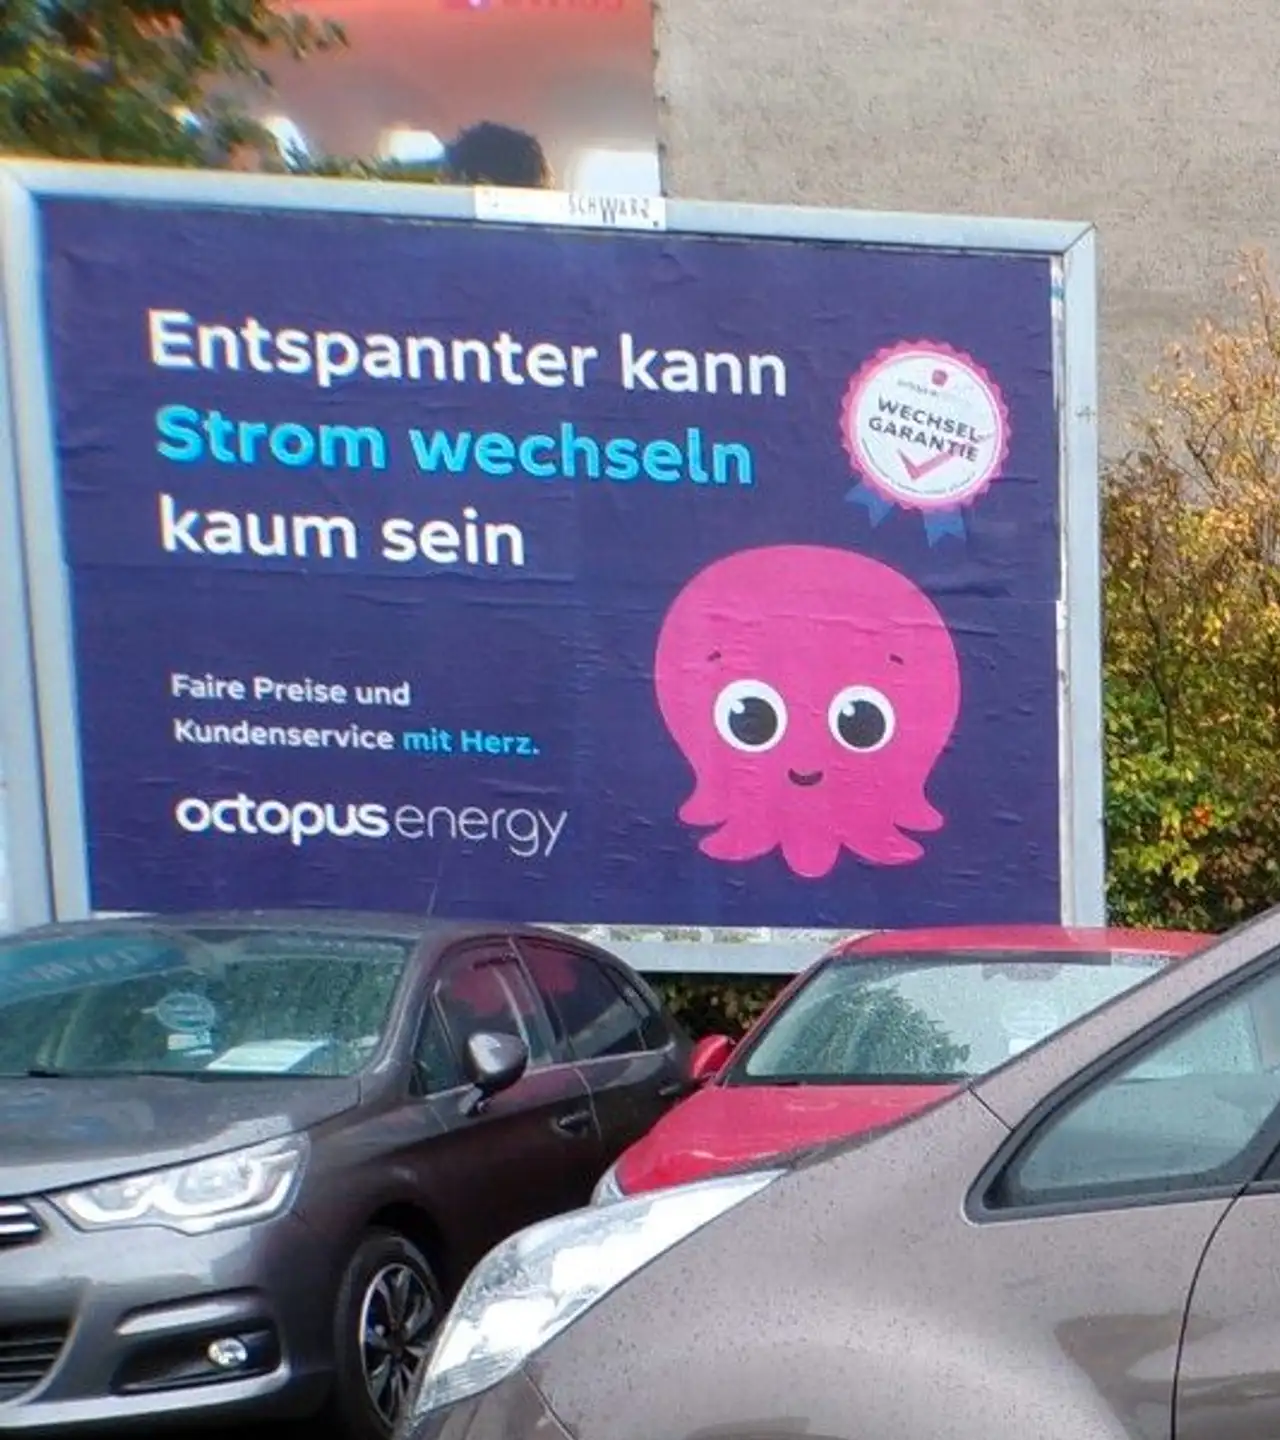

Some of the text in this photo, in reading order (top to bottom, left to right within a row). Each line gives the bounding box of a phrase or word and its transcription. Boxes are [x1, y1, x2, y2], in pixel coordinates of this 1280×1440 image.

[148, 309, 788, 396] Entspannter kann
[868, 416, 980, 462] GARANTIE
[877, 394, 980, 444] WECHSEL
[155, 404, 755, 485] Strom wechseln
[159, 493, 526, 566] kaum sein
[171, 673, 411, 707] Faire Preise und
[172, 717, 541, 756] Kundenservice mit Herz.
